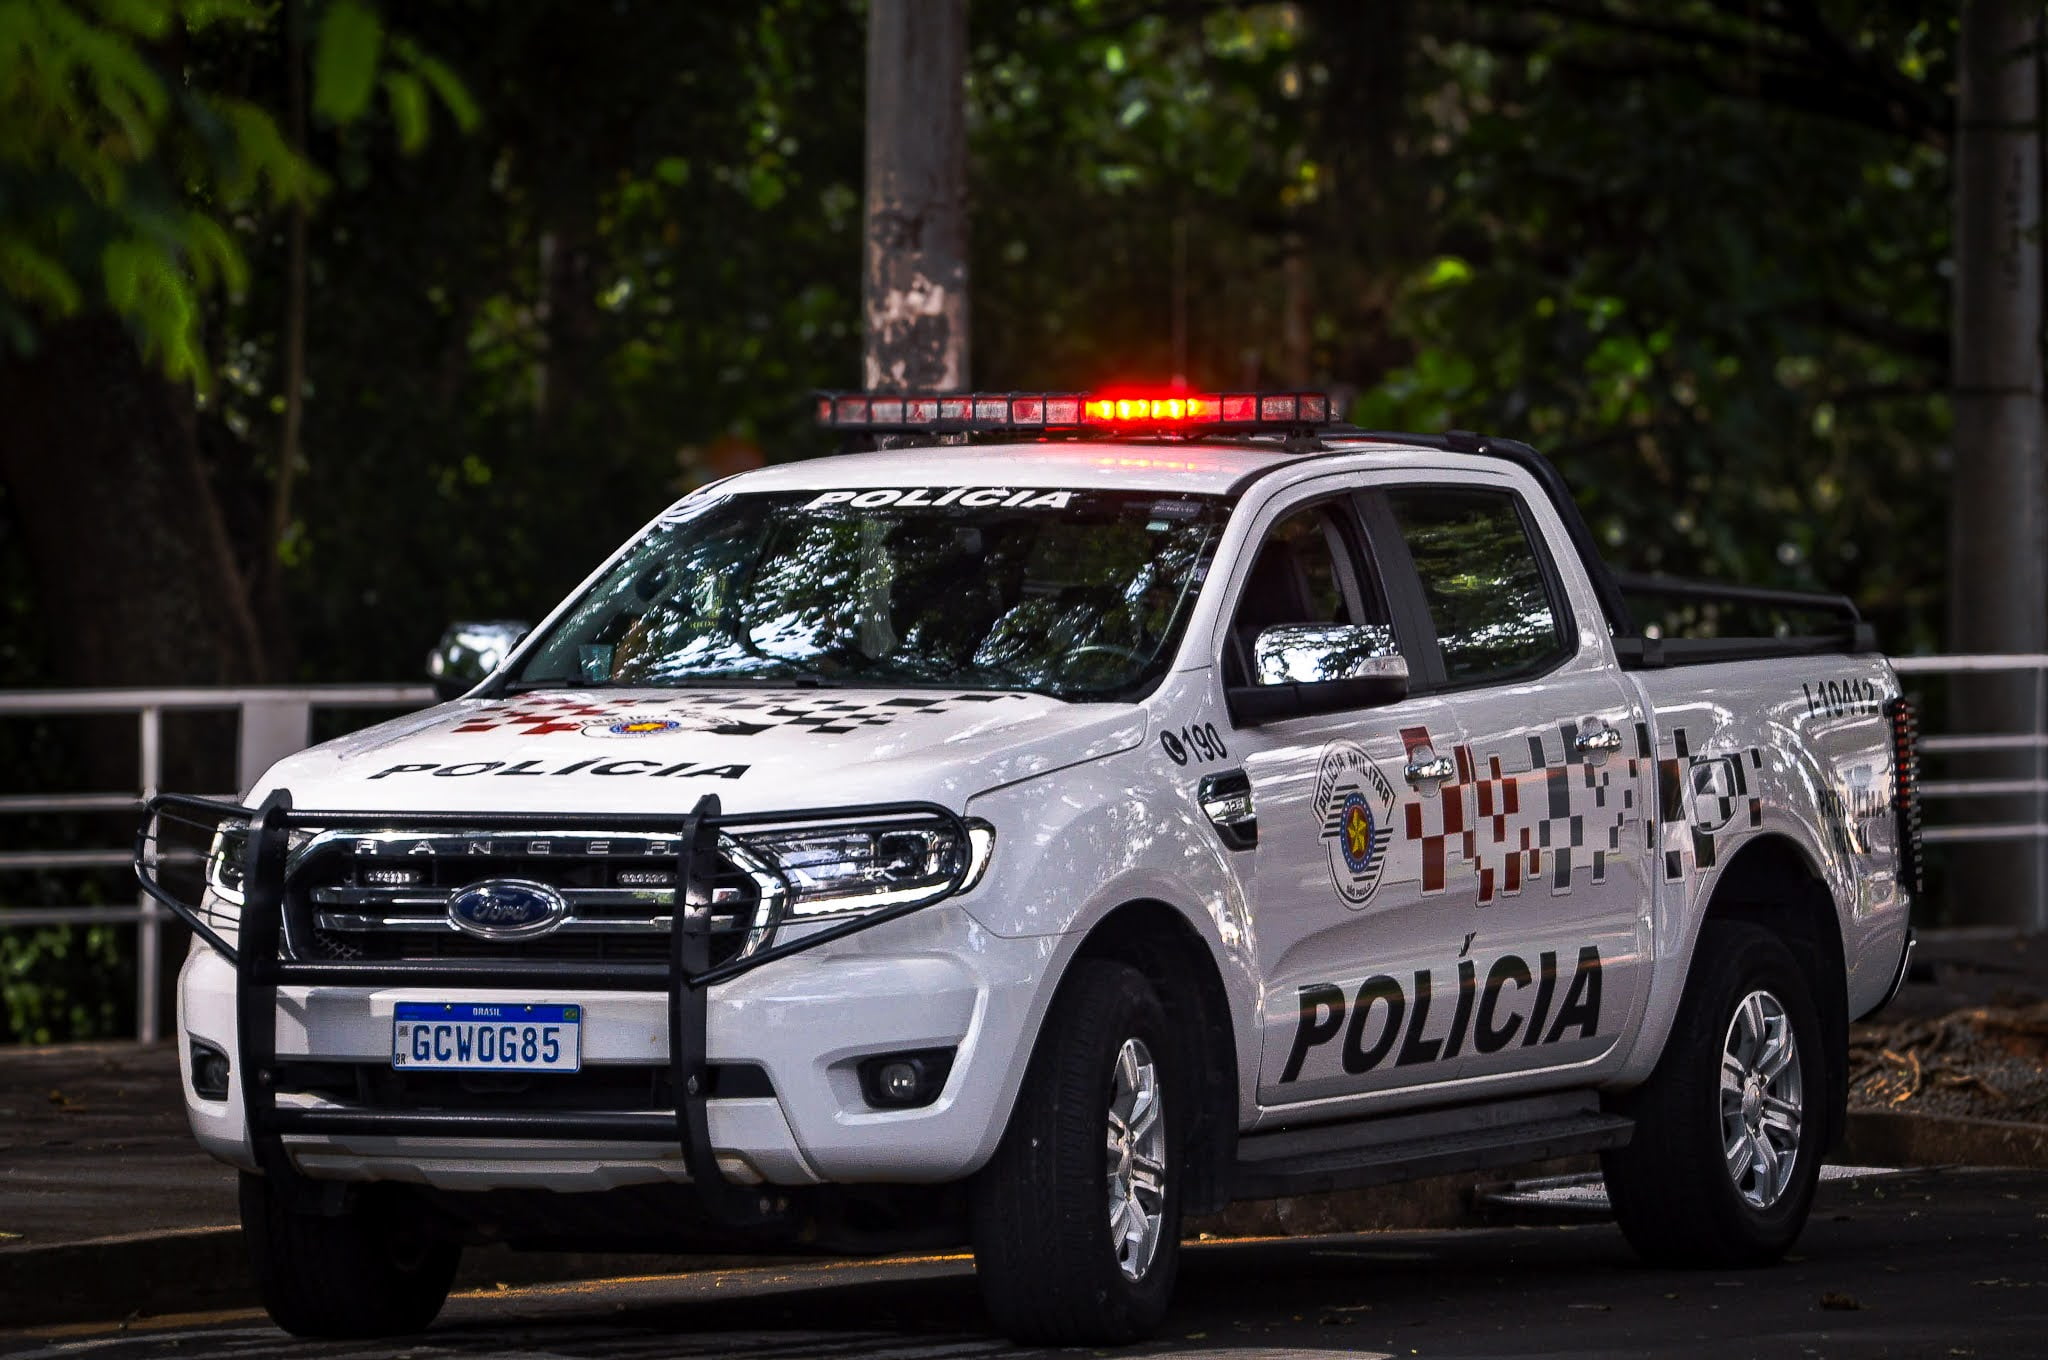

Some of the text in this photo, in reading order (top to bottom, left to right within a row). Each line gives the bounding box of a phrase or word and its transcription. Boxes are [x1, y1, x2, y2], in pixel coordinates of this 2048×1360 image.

[803, 485, 1072, 511] POLÍCIA
[1182, 722, 1227, 763] 190
[367, 756, 752, 780] POLÍCIA
[1347, 751, 1391, 807] MILITAR
[355, 840, 672, 856] RANGER
[473, 893, 532, 922] Ford
[472, 1007, 501, 1017] BRASIL
[1278, 931, 1604, 1084] POLÍCIA
[395, 1053, 406, 1065] BR
